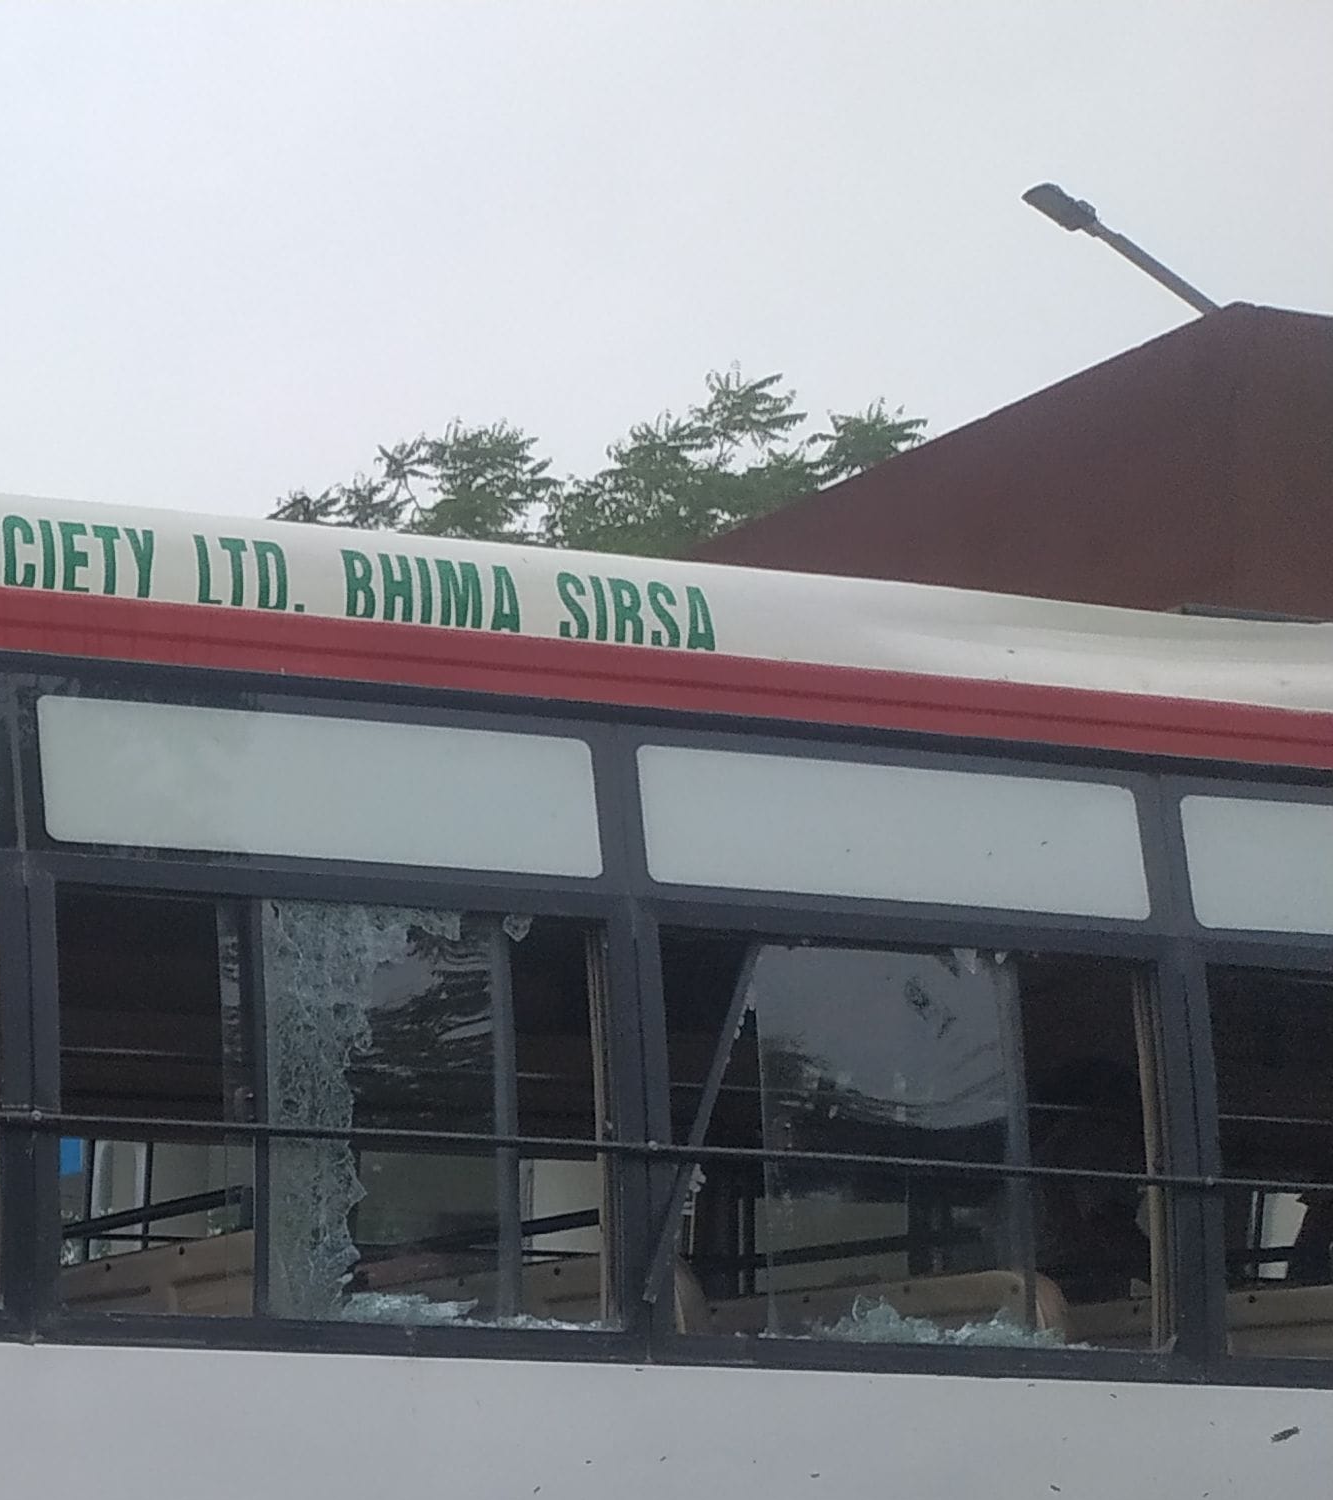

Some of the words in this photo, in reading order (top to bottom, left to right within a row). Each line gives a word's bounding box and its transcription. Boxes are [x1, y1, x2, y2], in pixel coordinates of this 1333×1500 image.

[194, 534, 305, 613] LTD.
[342, 549, 521, 633] BHIMA
[557, 571, 716, 651] SIRSA
